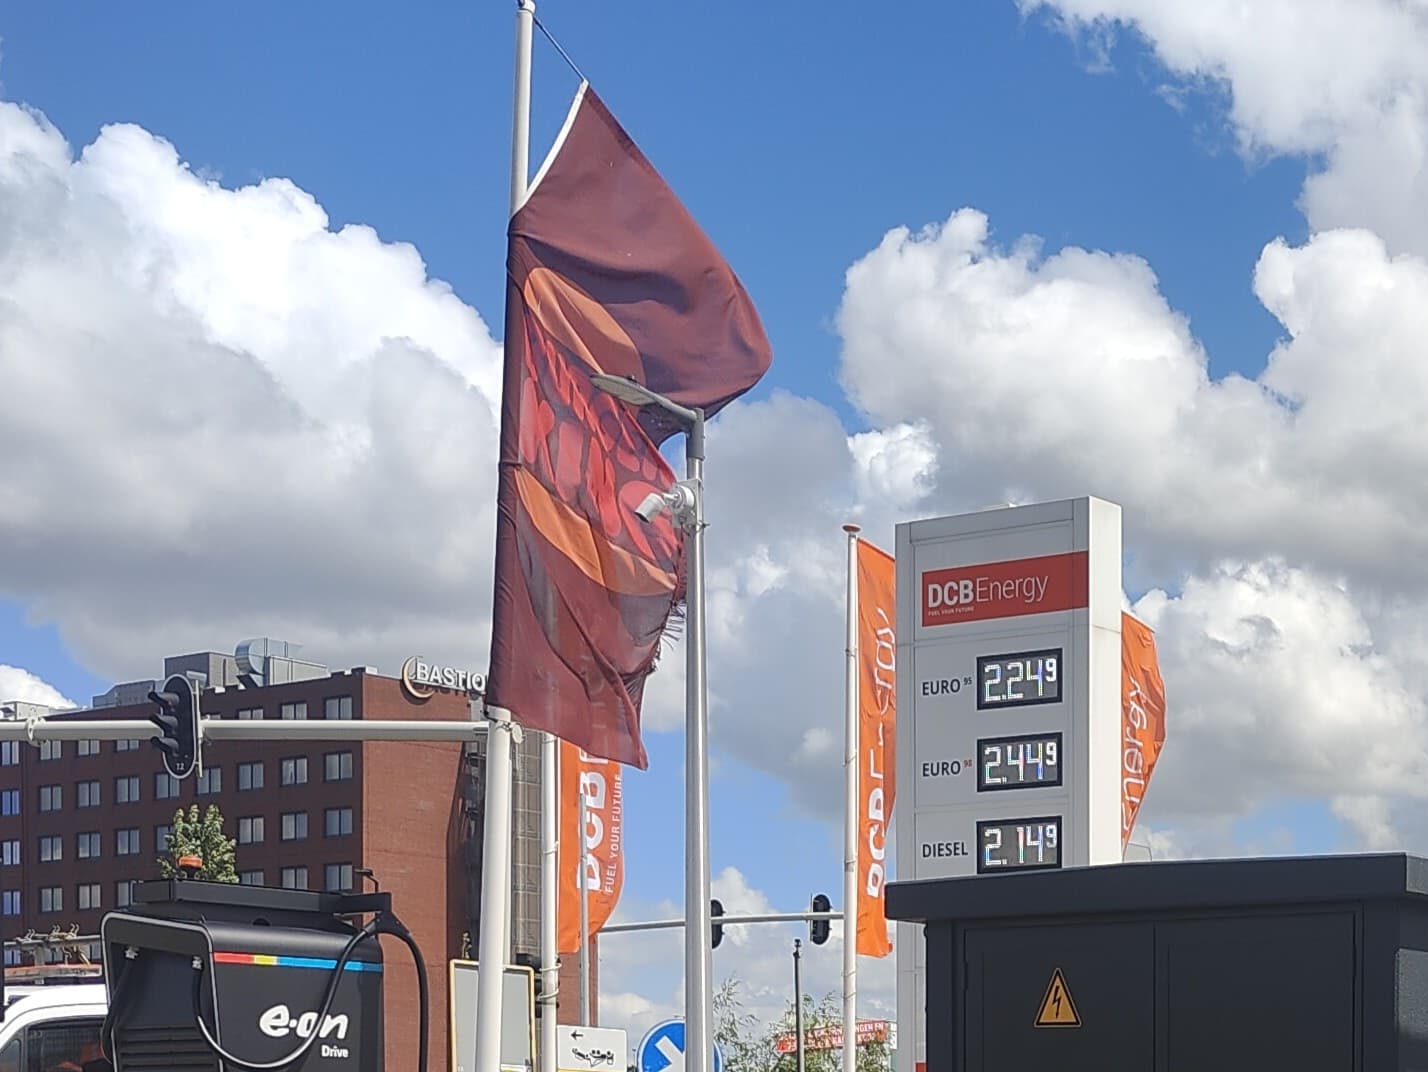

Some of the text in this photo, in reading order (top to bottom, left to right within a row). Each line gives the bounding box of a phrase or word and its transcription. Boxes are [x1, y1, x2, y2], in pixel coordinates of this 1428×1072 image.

[416, 661, 488, 693] BASTIO
[922, 678, 961, 696] EURO
[963, 677, 973, 685] 95
[922, 760, 961, 777] EURO
[609, 827, 621, 861] YOUR
[922, 841, 968, 858] DIESEL
[604, 863, 617, 894] FUEL
[321, 1044, 349, 1058] Drive
